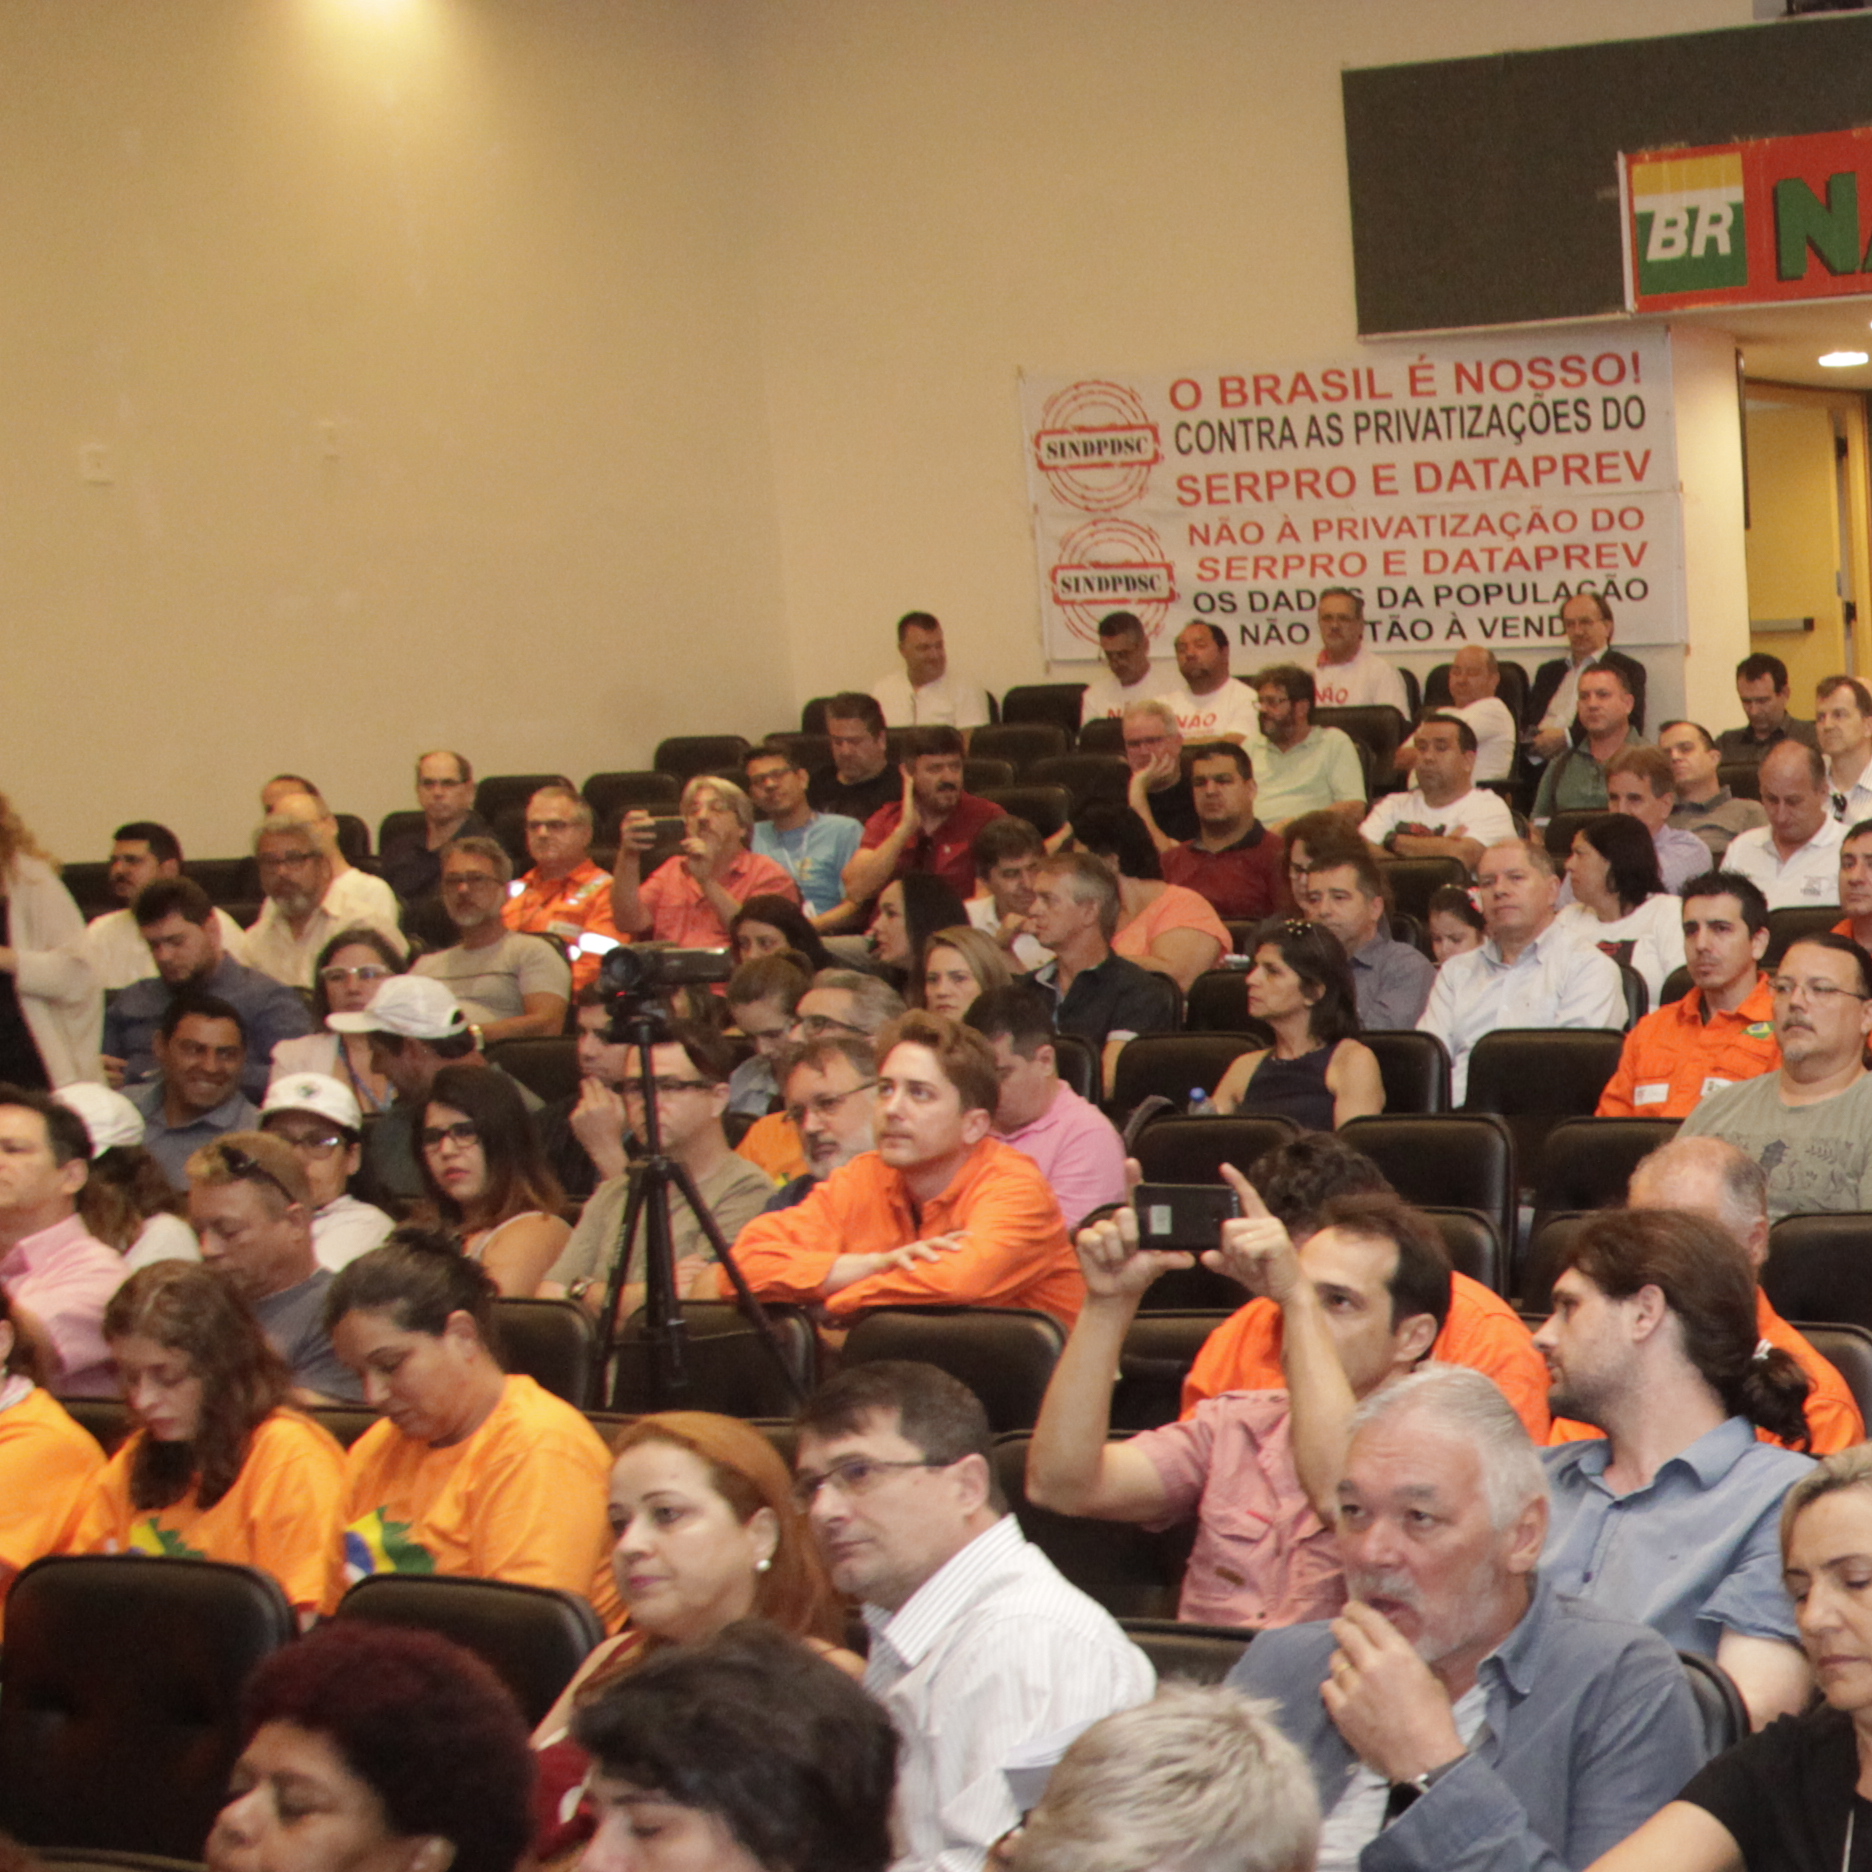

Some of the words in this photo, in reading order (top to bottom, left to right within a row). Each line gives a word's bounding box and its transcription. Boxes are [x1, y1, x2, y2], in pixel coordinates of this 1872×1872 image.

[1646, 201, 1734, 262] BR
[1169, 379, 1201, 411] O
[1218, 367, 1393, 409] BRASIL
[1409, 354, 1437, 397] É
[1454, 351, 1641, 396] NOSSO!
[1174, 414, 1297, 455] CONTRA
[1304, 411, 1344, 449] AS
[1355, 392, 1591, 446] PRIVATIZAÇÕES
[1602, 395, 1646, 431] DO
[1045, 437, 1150, 460] SINDPDSC
[1176, 465, 1357, 508] SERPRO
[1373, 463, 1396, 496] E
[1414, 448, 1653, 494] DATAPREV
[1188, 514, 1264, 546] NÃO
[1276, 511, 1301, 544] À
[1313, 505, 1578, 543] PRIVATIZAÇÃO
[1591, 506, 1644, 532] DO
[1196, 551, 1367, 583] SERPRO
[1383, 548, 1407, 577] E
[1421, 541, 1650, 575] DATAPREV
[1060, 573, 1162, 594] SINDPDSC
[1193, 591, 1237, 614] OS
[1248, 587, 1363, 613] DAD
[1377, 585, 1424, 609] DA
[1240, 618, 1310, 646] NÃO
[1444, 611, 1467, 640] À
[1477, 615, 1567, 639] VEND
